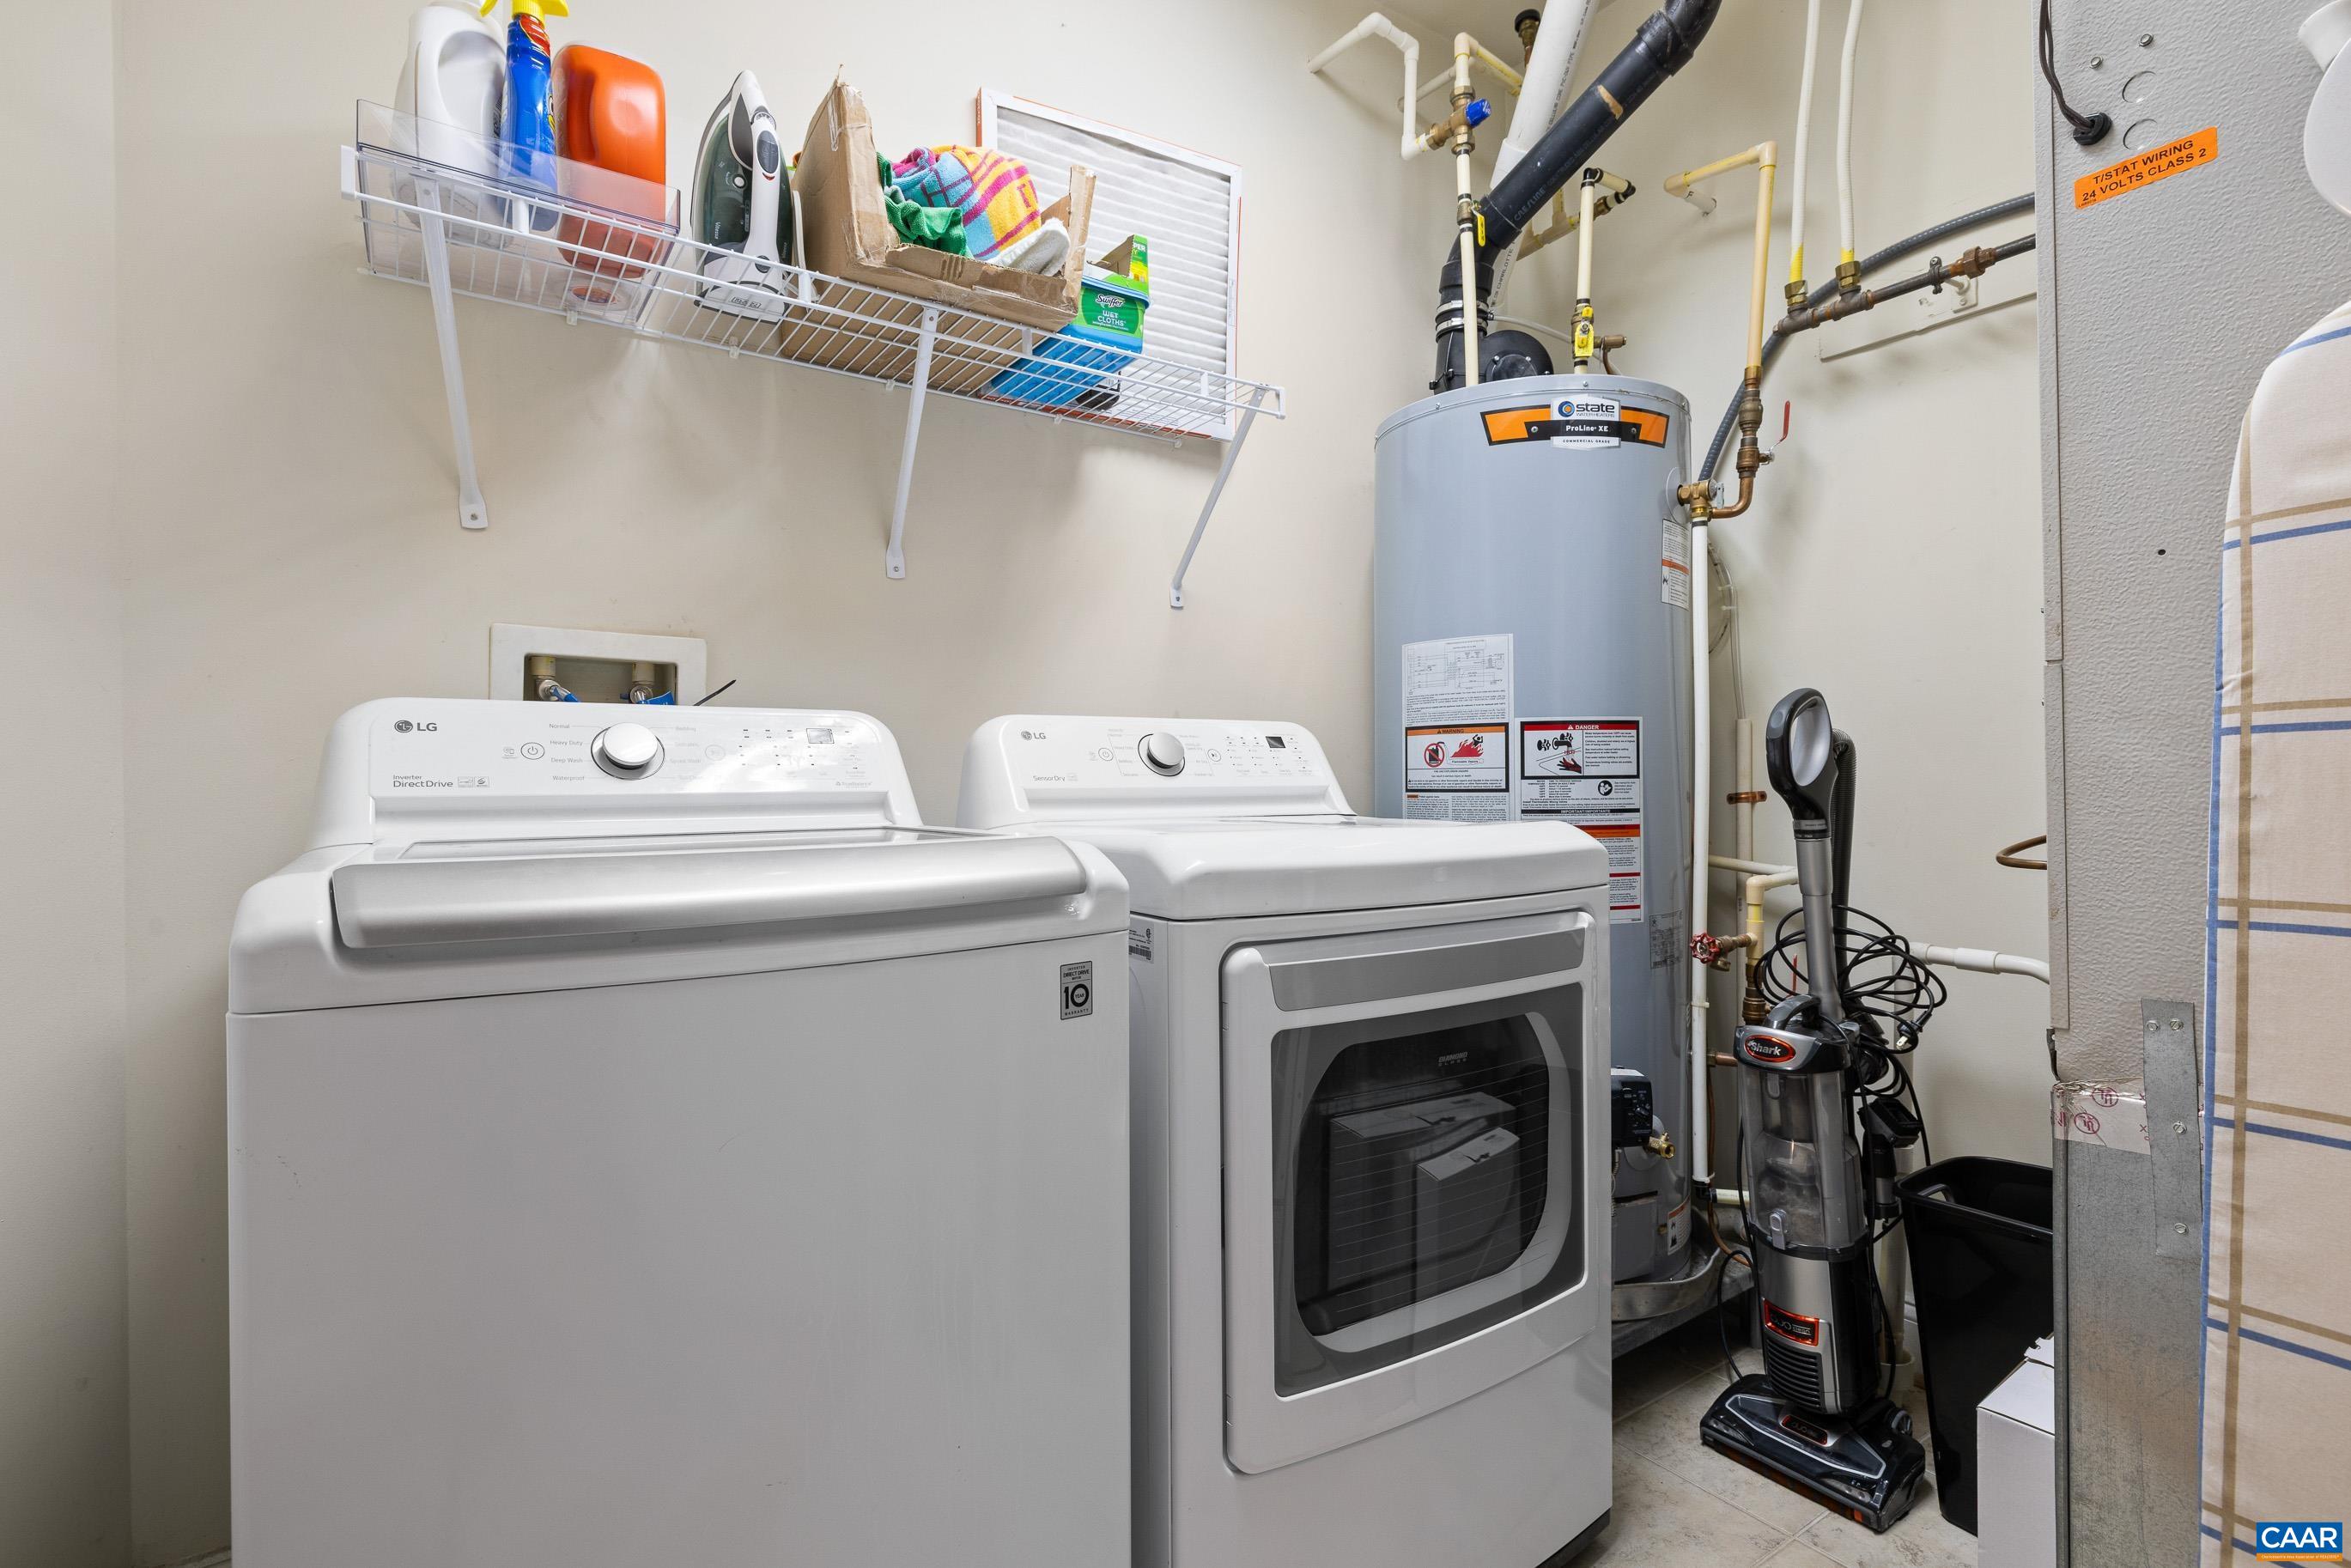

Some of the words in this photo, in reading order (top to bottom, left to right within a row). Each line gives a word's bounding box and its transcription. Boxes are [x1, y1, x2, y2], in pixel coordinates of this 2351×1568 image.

[2093, 161, 2138, 185] T/STAT
[2141, 140, 2194, 167] WIRING
[2082, 190, 2097, 202] 24
[2099, 172, 2144, 194] VOLTS
[2147, 153, 2194, 176] CLASS
[2199, 149, 2207, 158] 2
[1096, 294, 1123, 307] Swiffer
[1103, 310, 1119, 319] WET
[1576, 403, 1615, 413] state
[416, 722, 438, 732] LG
[1064, 983, 1090, 1010] 10
[1751, 1043, 1782, 1056] Shark
